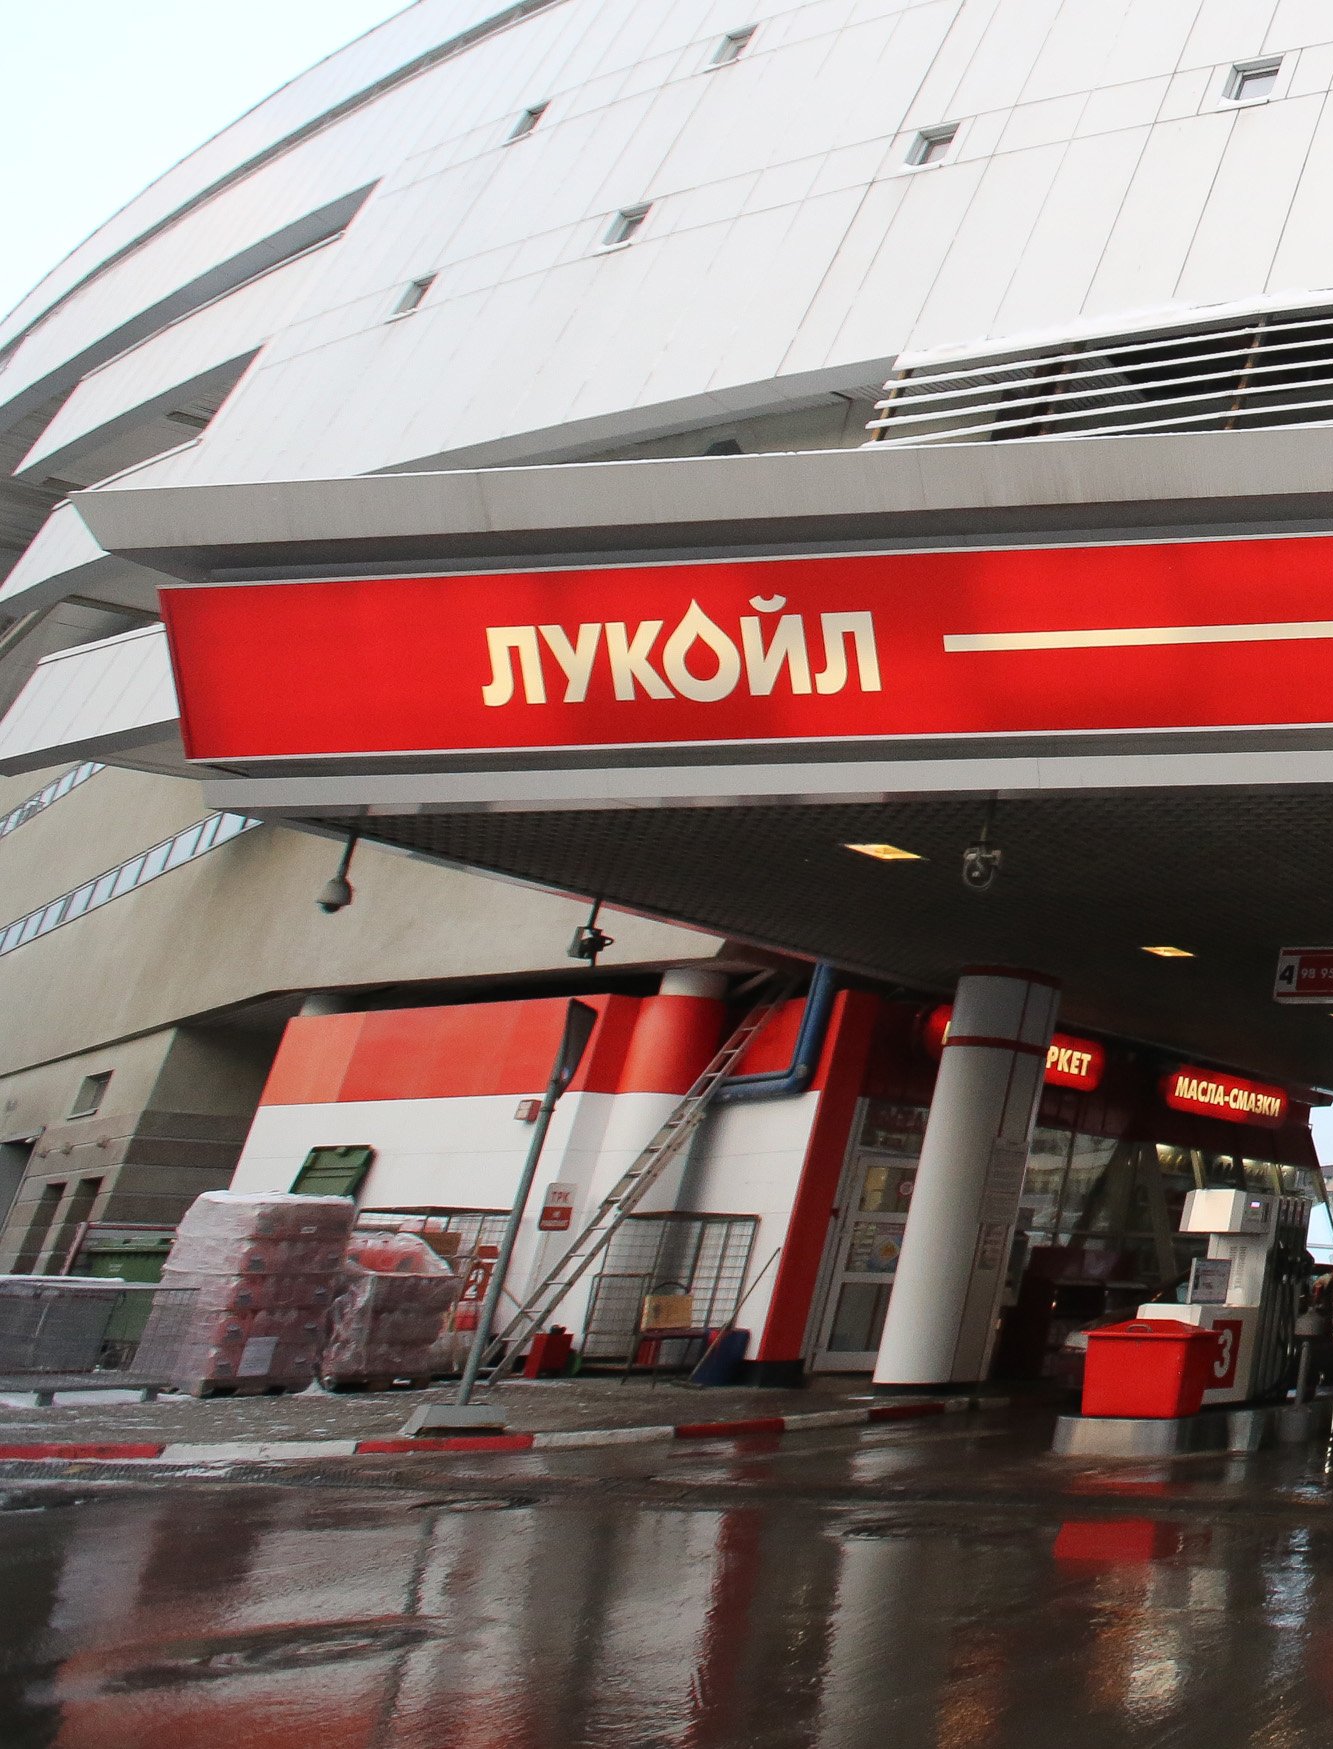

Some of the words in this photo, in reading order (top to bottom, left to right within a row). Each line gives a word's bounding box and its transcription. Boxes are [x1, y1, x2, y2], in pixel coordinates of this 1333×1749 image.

[482, 593, 882, 706] ЛУКОЙЛ
[1279, 964, 1295, 985] 4
[1046, 1045, 1092, 1077] РКЕТ
[1174, 1075, 1281, 1117] МАСЛА-СМАЗКИ
[1213, 1328, 1233, 1378] 3
